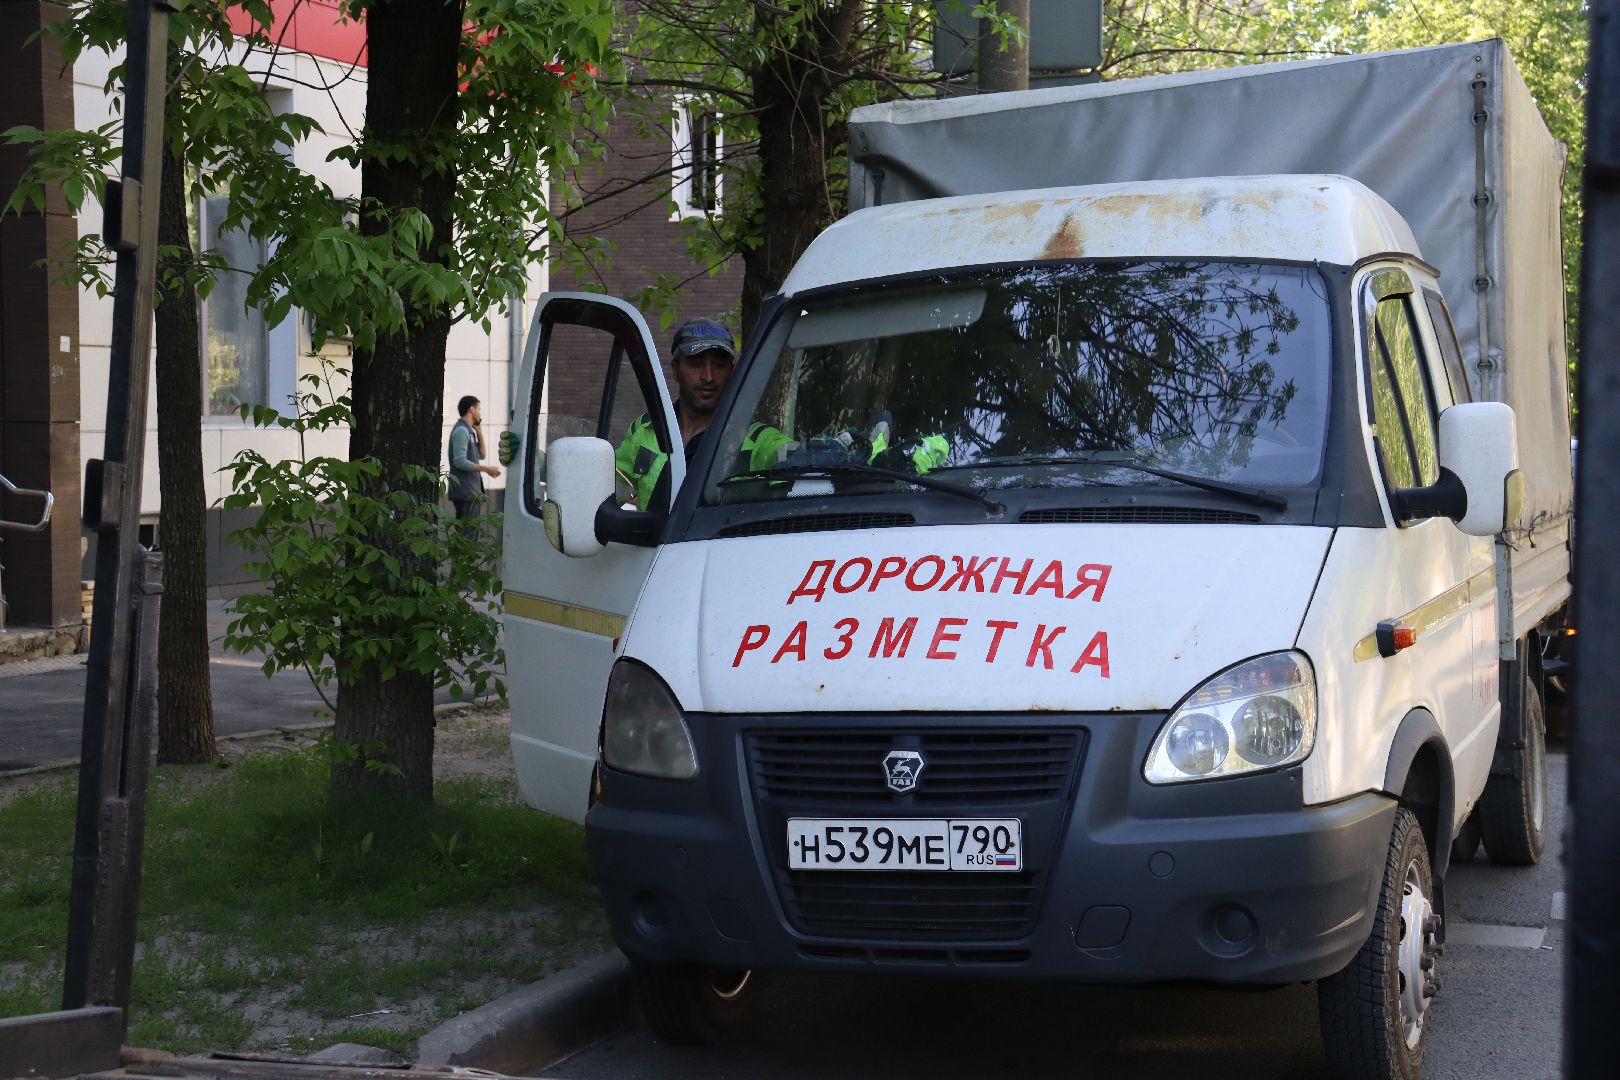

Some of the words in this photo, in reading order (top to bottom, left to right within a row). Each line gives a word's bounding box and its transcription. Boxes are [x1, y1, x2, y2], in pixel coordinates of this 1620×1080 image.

[786, 554, 1112, 605] ДОРОЖНАЯ
[732, 616, 1111, 678] РАЗМЕТКА
[800, 826, 945, 864] Н539МЕ
[952, 825, 1011, 855] 790
[966, 854, 994, 865] RUS
